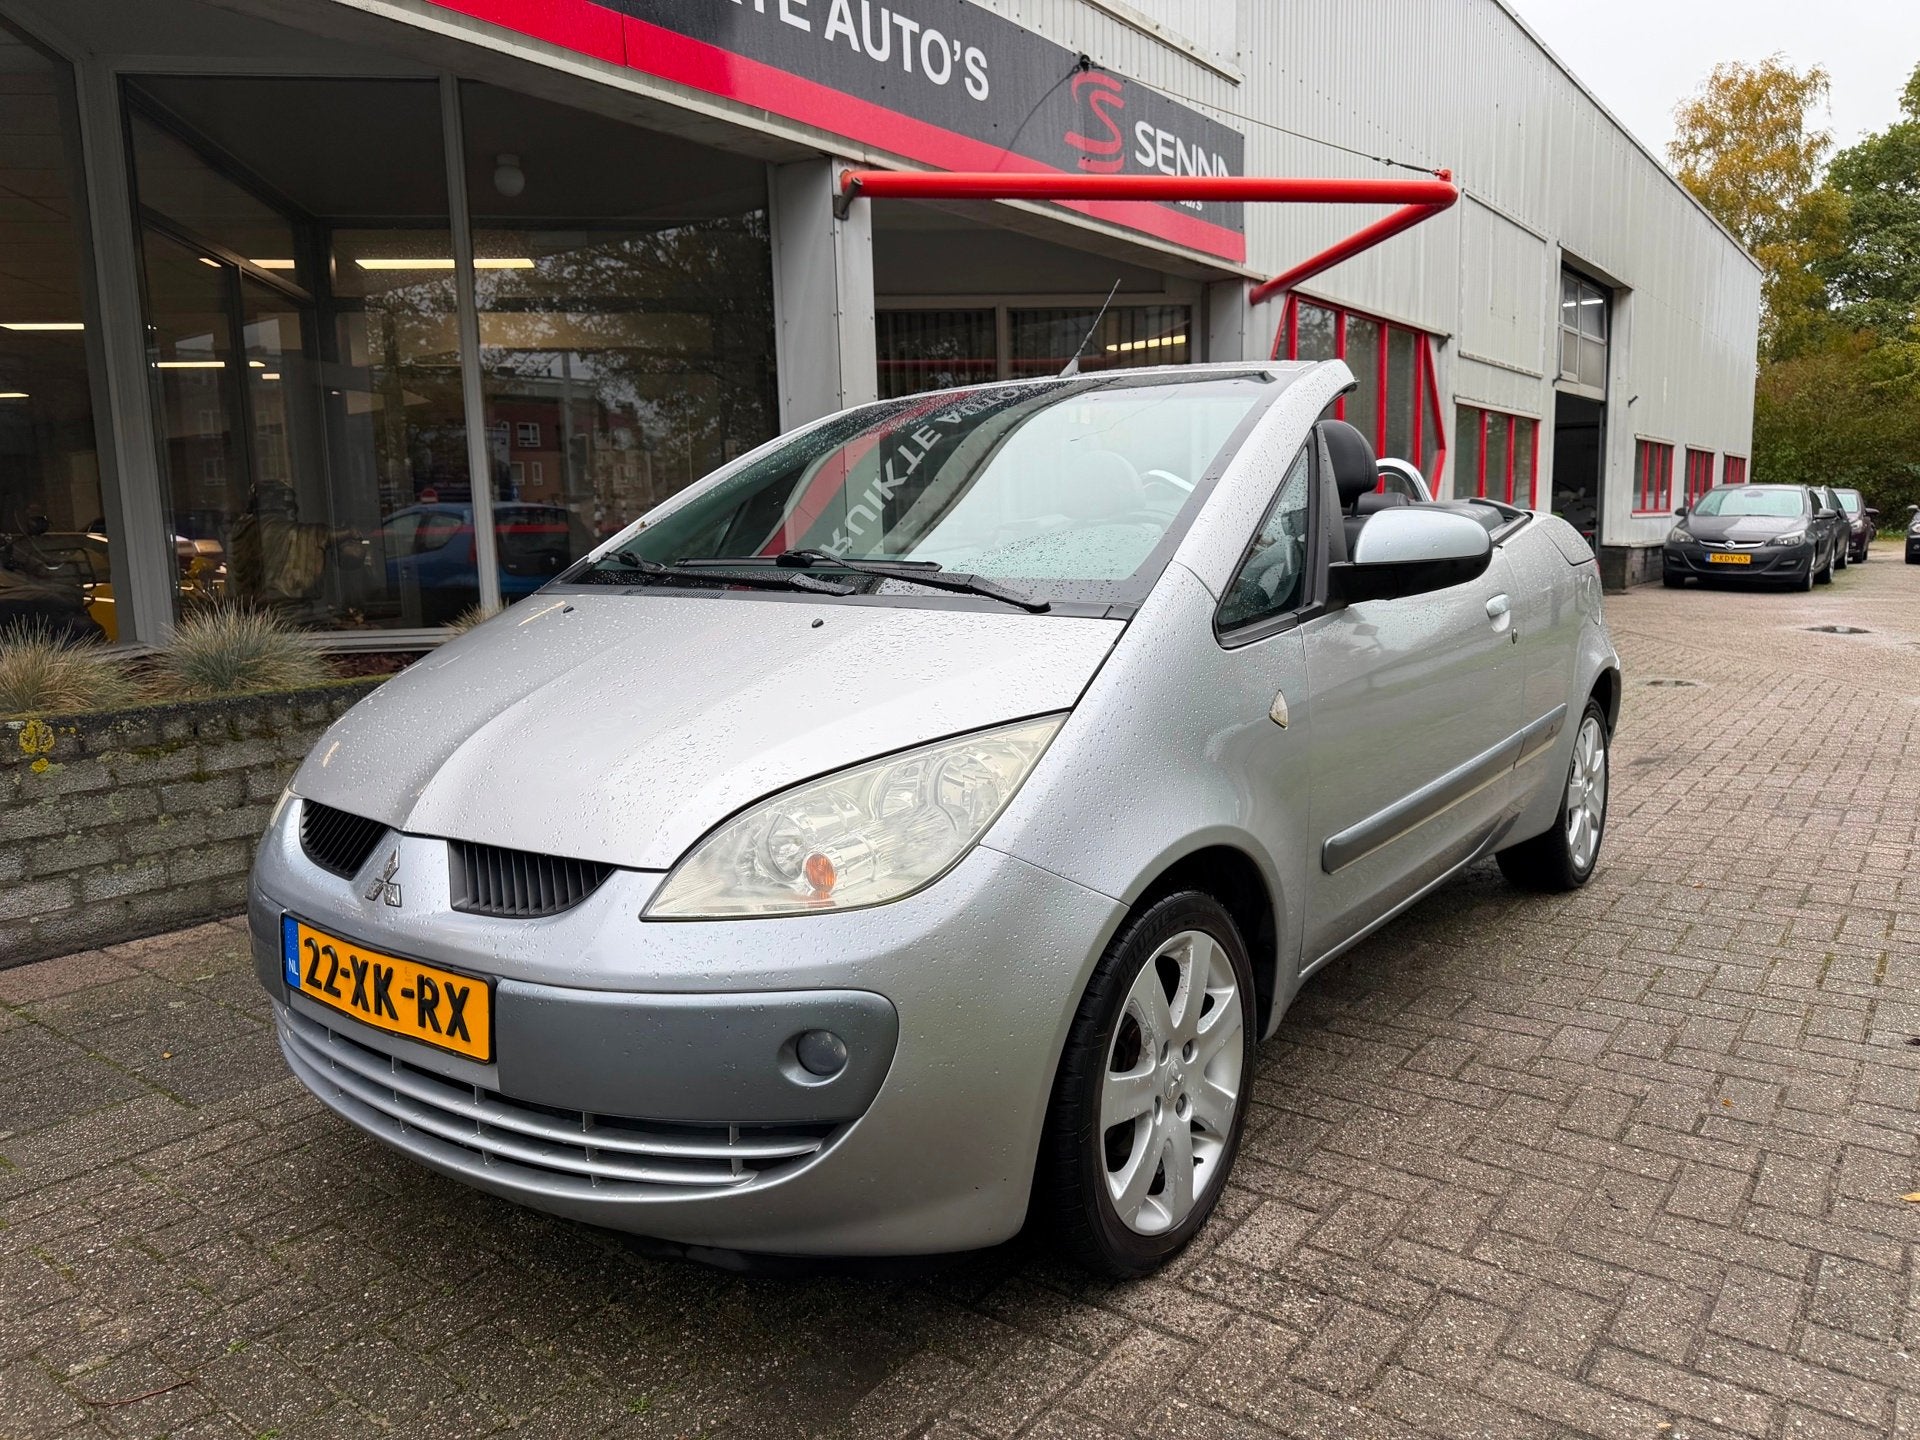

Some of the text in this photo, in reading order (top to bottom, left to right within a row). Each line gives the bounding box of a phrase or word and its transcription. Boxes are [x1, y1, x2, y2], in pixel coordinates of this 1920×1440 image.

[824, 0, 990, 101] AUTO'S
[288, 957, 299, 976] NL
[303, 937, 471, 1043] 22-XK-RX
